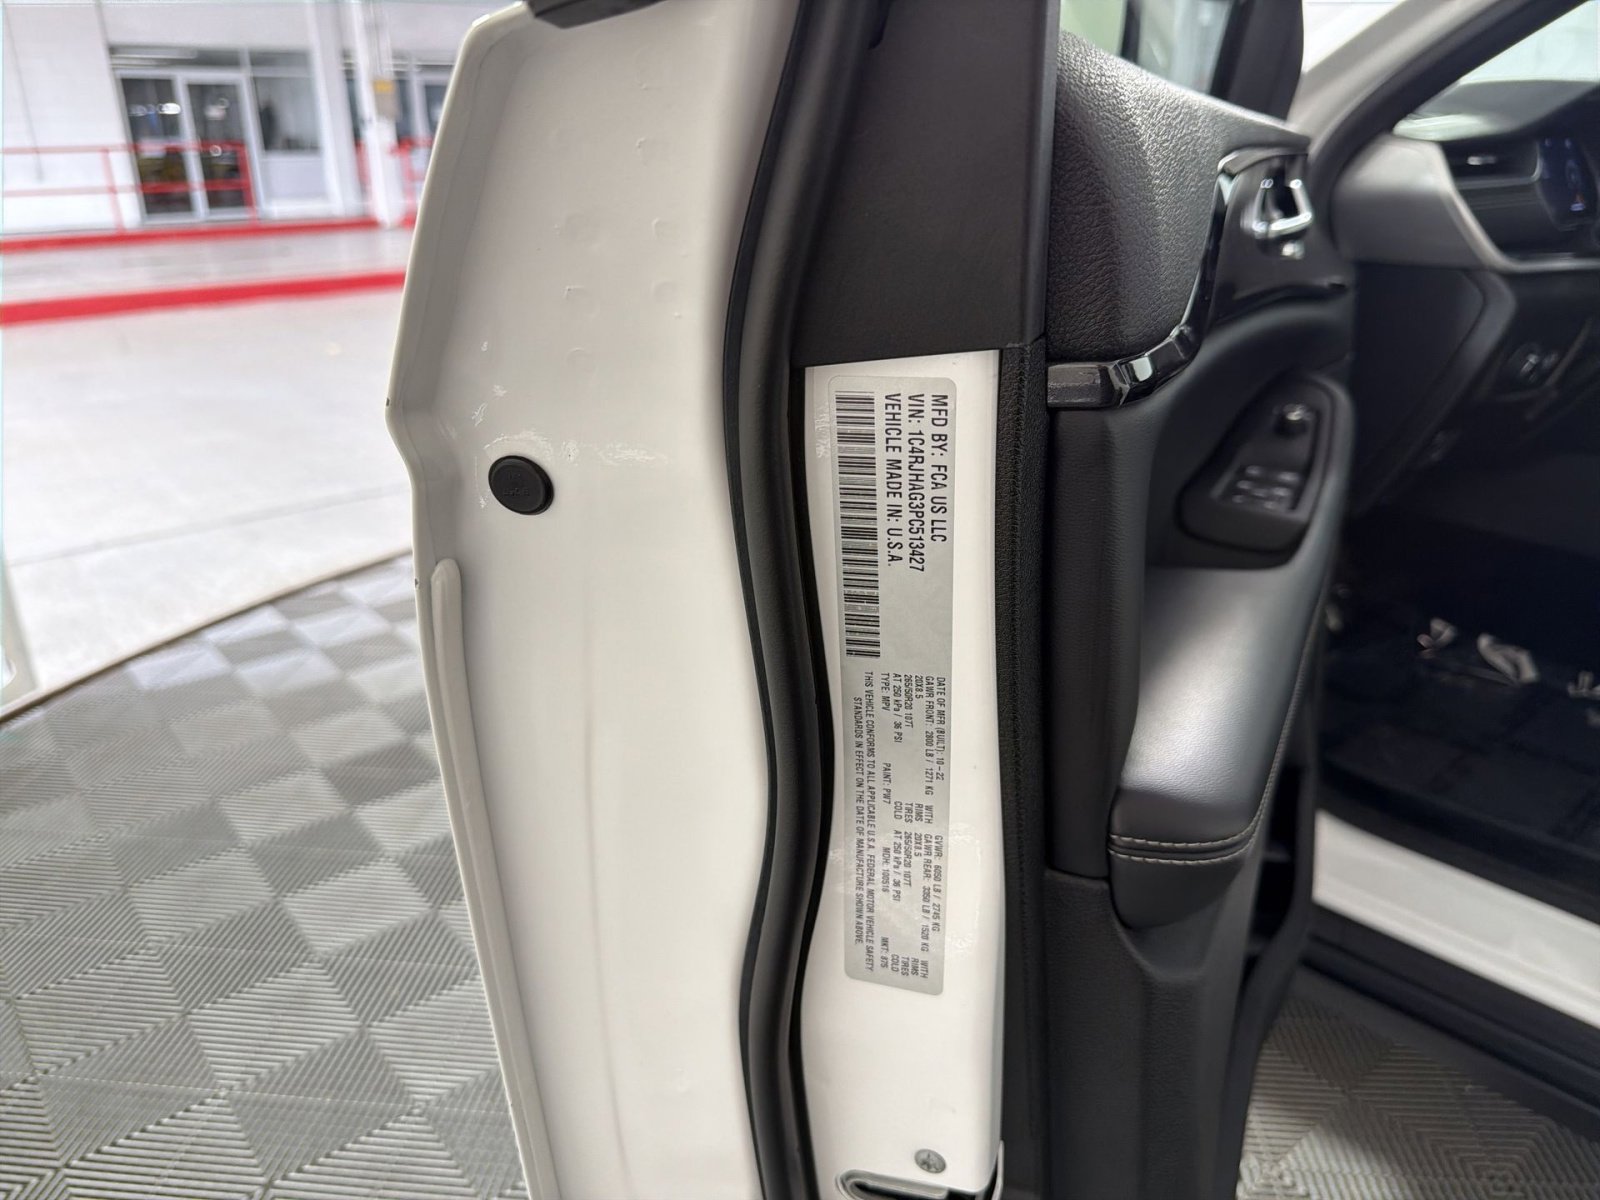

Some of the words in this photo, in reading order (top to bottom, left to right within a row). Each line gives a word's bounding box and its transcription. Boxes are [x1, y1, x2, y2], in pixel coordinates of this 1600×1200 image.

[908, 394, 925, 423] VIN:
[932, 394, 948, 427] MFD
[885, 393, 902, 453] VEHICLE
[931, 433, 948, 456] BY:
[886, 459, 902, 498] MADE
[931, 465, 947, 490] FCA
[908, 430, 925, 572] 1C4RJHAG3PC513427
[931, 496, 947, 514] US
[887, 504, 902, 522] IN:
[931, 519, 947, 542] LLC
[887, 528, 903, 567] U.S.A.
[865, 672, 873, 687] THIS
[881, 673, 890, 693] TYPE:
[893, 673, 901, 682] AT
[926, 676, 934, 698] GAWR
[937, 677, 945, 695] DATE
[893, 685, 901, 696] 250
[904, 675, 912, 709] 265/50R20
[865, 690, 874, 718] VEHICLE
[882, 696, 890, 711] MPV
[937, 698, 945, 707] OF
[854, 697, 863, 738] STANDARDS
[905, 713, 913, 728] 107T
[926, 700, 934, 726] FRONT:
[937, 710, 945, 724] MFR
[894, 721, 901, 729] 36
[866, 720, 875, 757] CONFORMS
[926, 749, 933, 757] LB
[855, 751, 864, 775] EFFECT
[867, 760, 875, 769] TO
[856, 778, 864, 787] ON
[867, 771, 875, 783] ALL
[883, 763, 891, 785] PAINT:
[925, 768, 933, 783] 1271
[856, 790, 864, 803] THE
[883, 788, 891, 804] PW7
[925, 786, 933, 795] KG
[856, 806, 864, 824] DATE
[867, 786, 876, 828] APPLICABLE
[905, 803, 913, 823] TIRES
[915, 803, 923, 821] RIMS
[925, 805, 933, 824] WITH
[856, 827, 864, 836] OF
[867, 830, 875, 851] U.S.A.
[894, 830, 902, 839] AT
[904, 831, 912, 868] 265/50R20
[924, 834, 932, 855] GAWR
[934, 835, 942, 859] GVWR:
[856, 838, 864, 890] MANUFACTURE
[882, 847, 890, 865] MDH:
[893, 857, 901, 868] kPa
[923, 859, 931, 881] REAR:
[933, 884, 941, 893] LB
[856, 893, 864, 919] SHOWN
[866, 889, 874, 913] MOTOR
[922, 905, 930, 913] LB
[932, 903, 940, 920] 2745
[855, 921, 863, 945] ABOVE.
[866, 915, 874, 943] VEHICLE
[932, 922, 940, 931] KG
[921, 942, 929, 952] KG
[865, 945, 873, 971] SAFETY
[891, 954, 899, 972] COLD
[901, 956, 909, 976] TIRES
